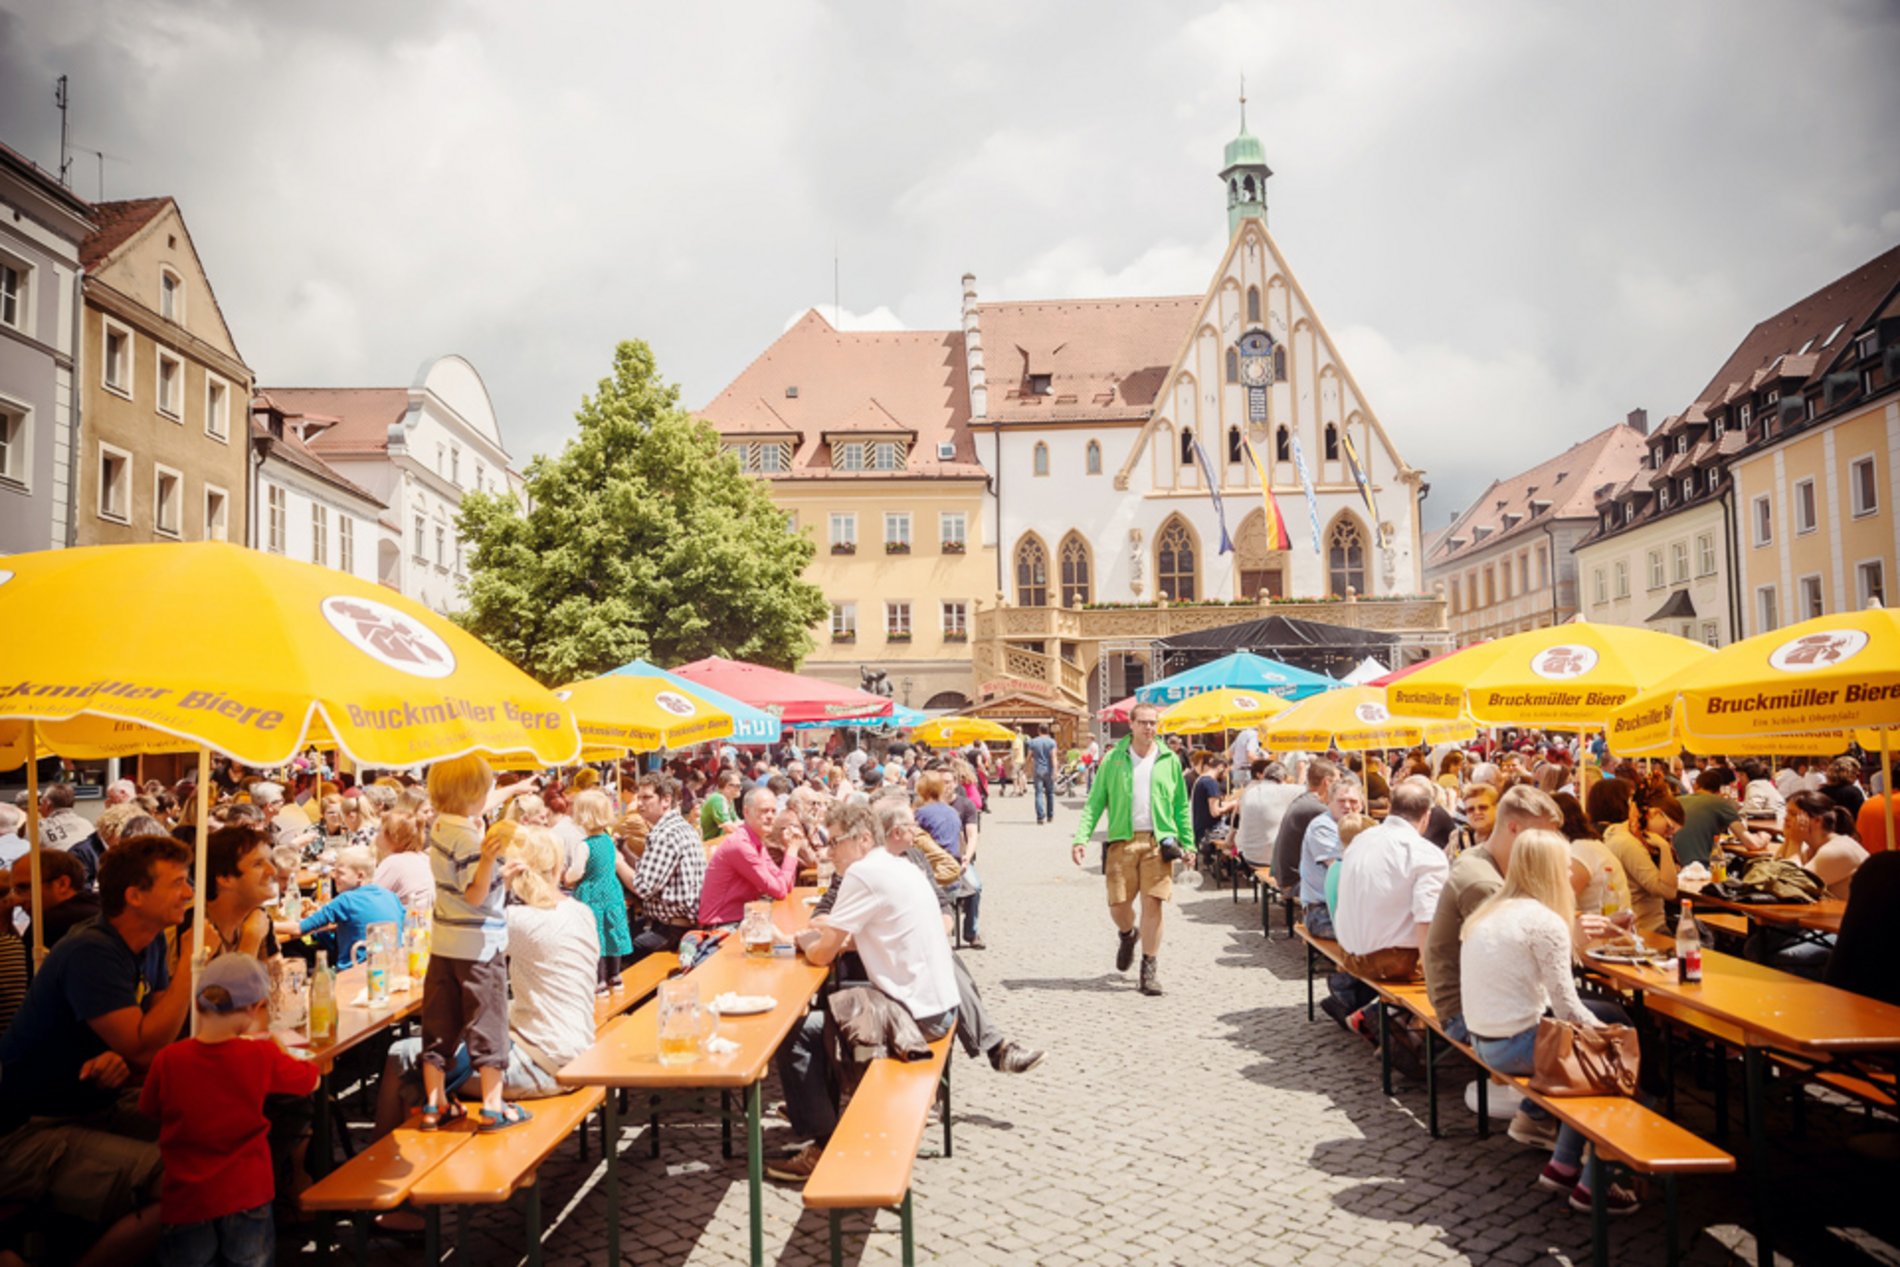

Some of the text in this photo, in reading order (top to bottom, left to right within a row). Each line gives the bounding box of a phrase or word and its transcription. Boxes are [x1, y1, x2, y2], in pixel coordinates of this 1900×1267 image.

[1167, 684, 1226, 700] SH
[1395, 690, 1443, 706] Bruckmüller
[1488, 691, 1626, 707] Bruckmüller Biere
[1707, 681, 1900, 714] Bruckmüller Biere
[0, 678, 285, 731] ckmüller Biere
[345, 696, 561, 730] Bruckmüller Biere
[734, 719, 774, 736] HUI
[1615, 708, 1663, 733] Bruckmüller
[1772, 712, 1806, 726] Schluck
[45, 825, 68, 842] 63
